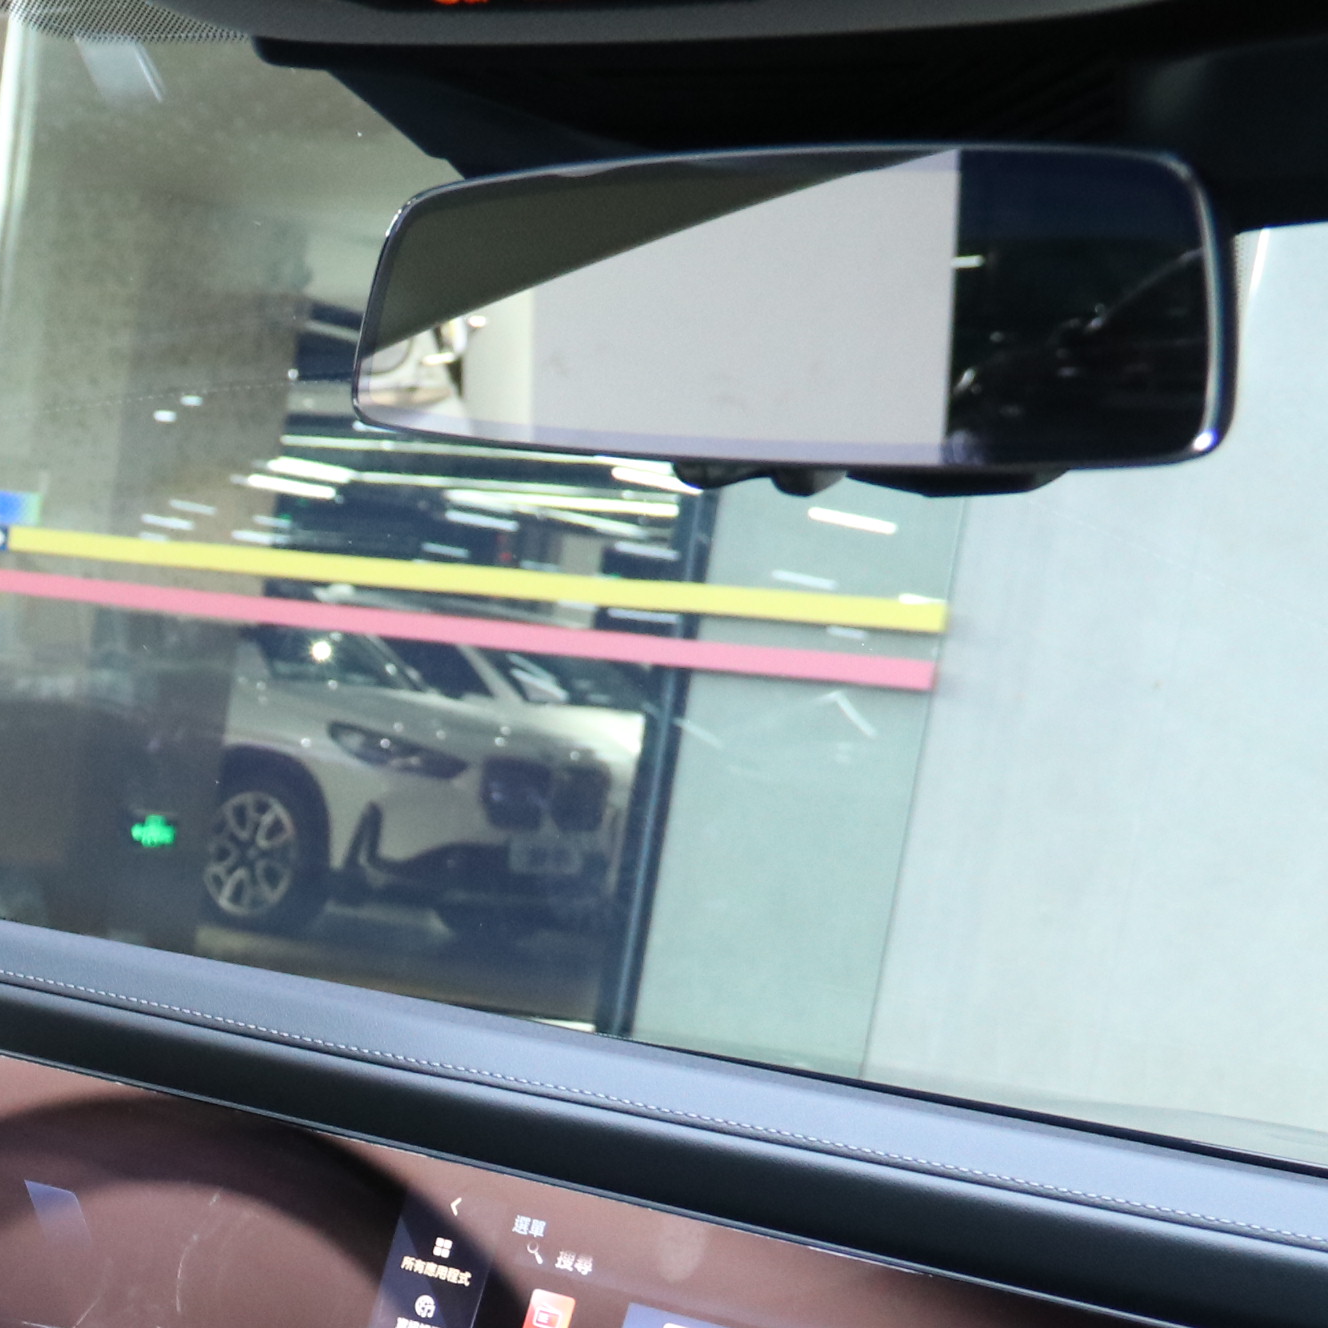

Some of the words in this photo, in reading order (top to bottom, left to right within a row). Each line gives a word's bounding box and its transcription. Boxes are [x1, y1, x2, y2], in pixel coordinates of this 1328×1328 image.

[512, 1214, 546, 1238] 選單
[400, 1255, 473, 1287] 所有應用程式
[555, 1250, 593, 1276] 搜尋
